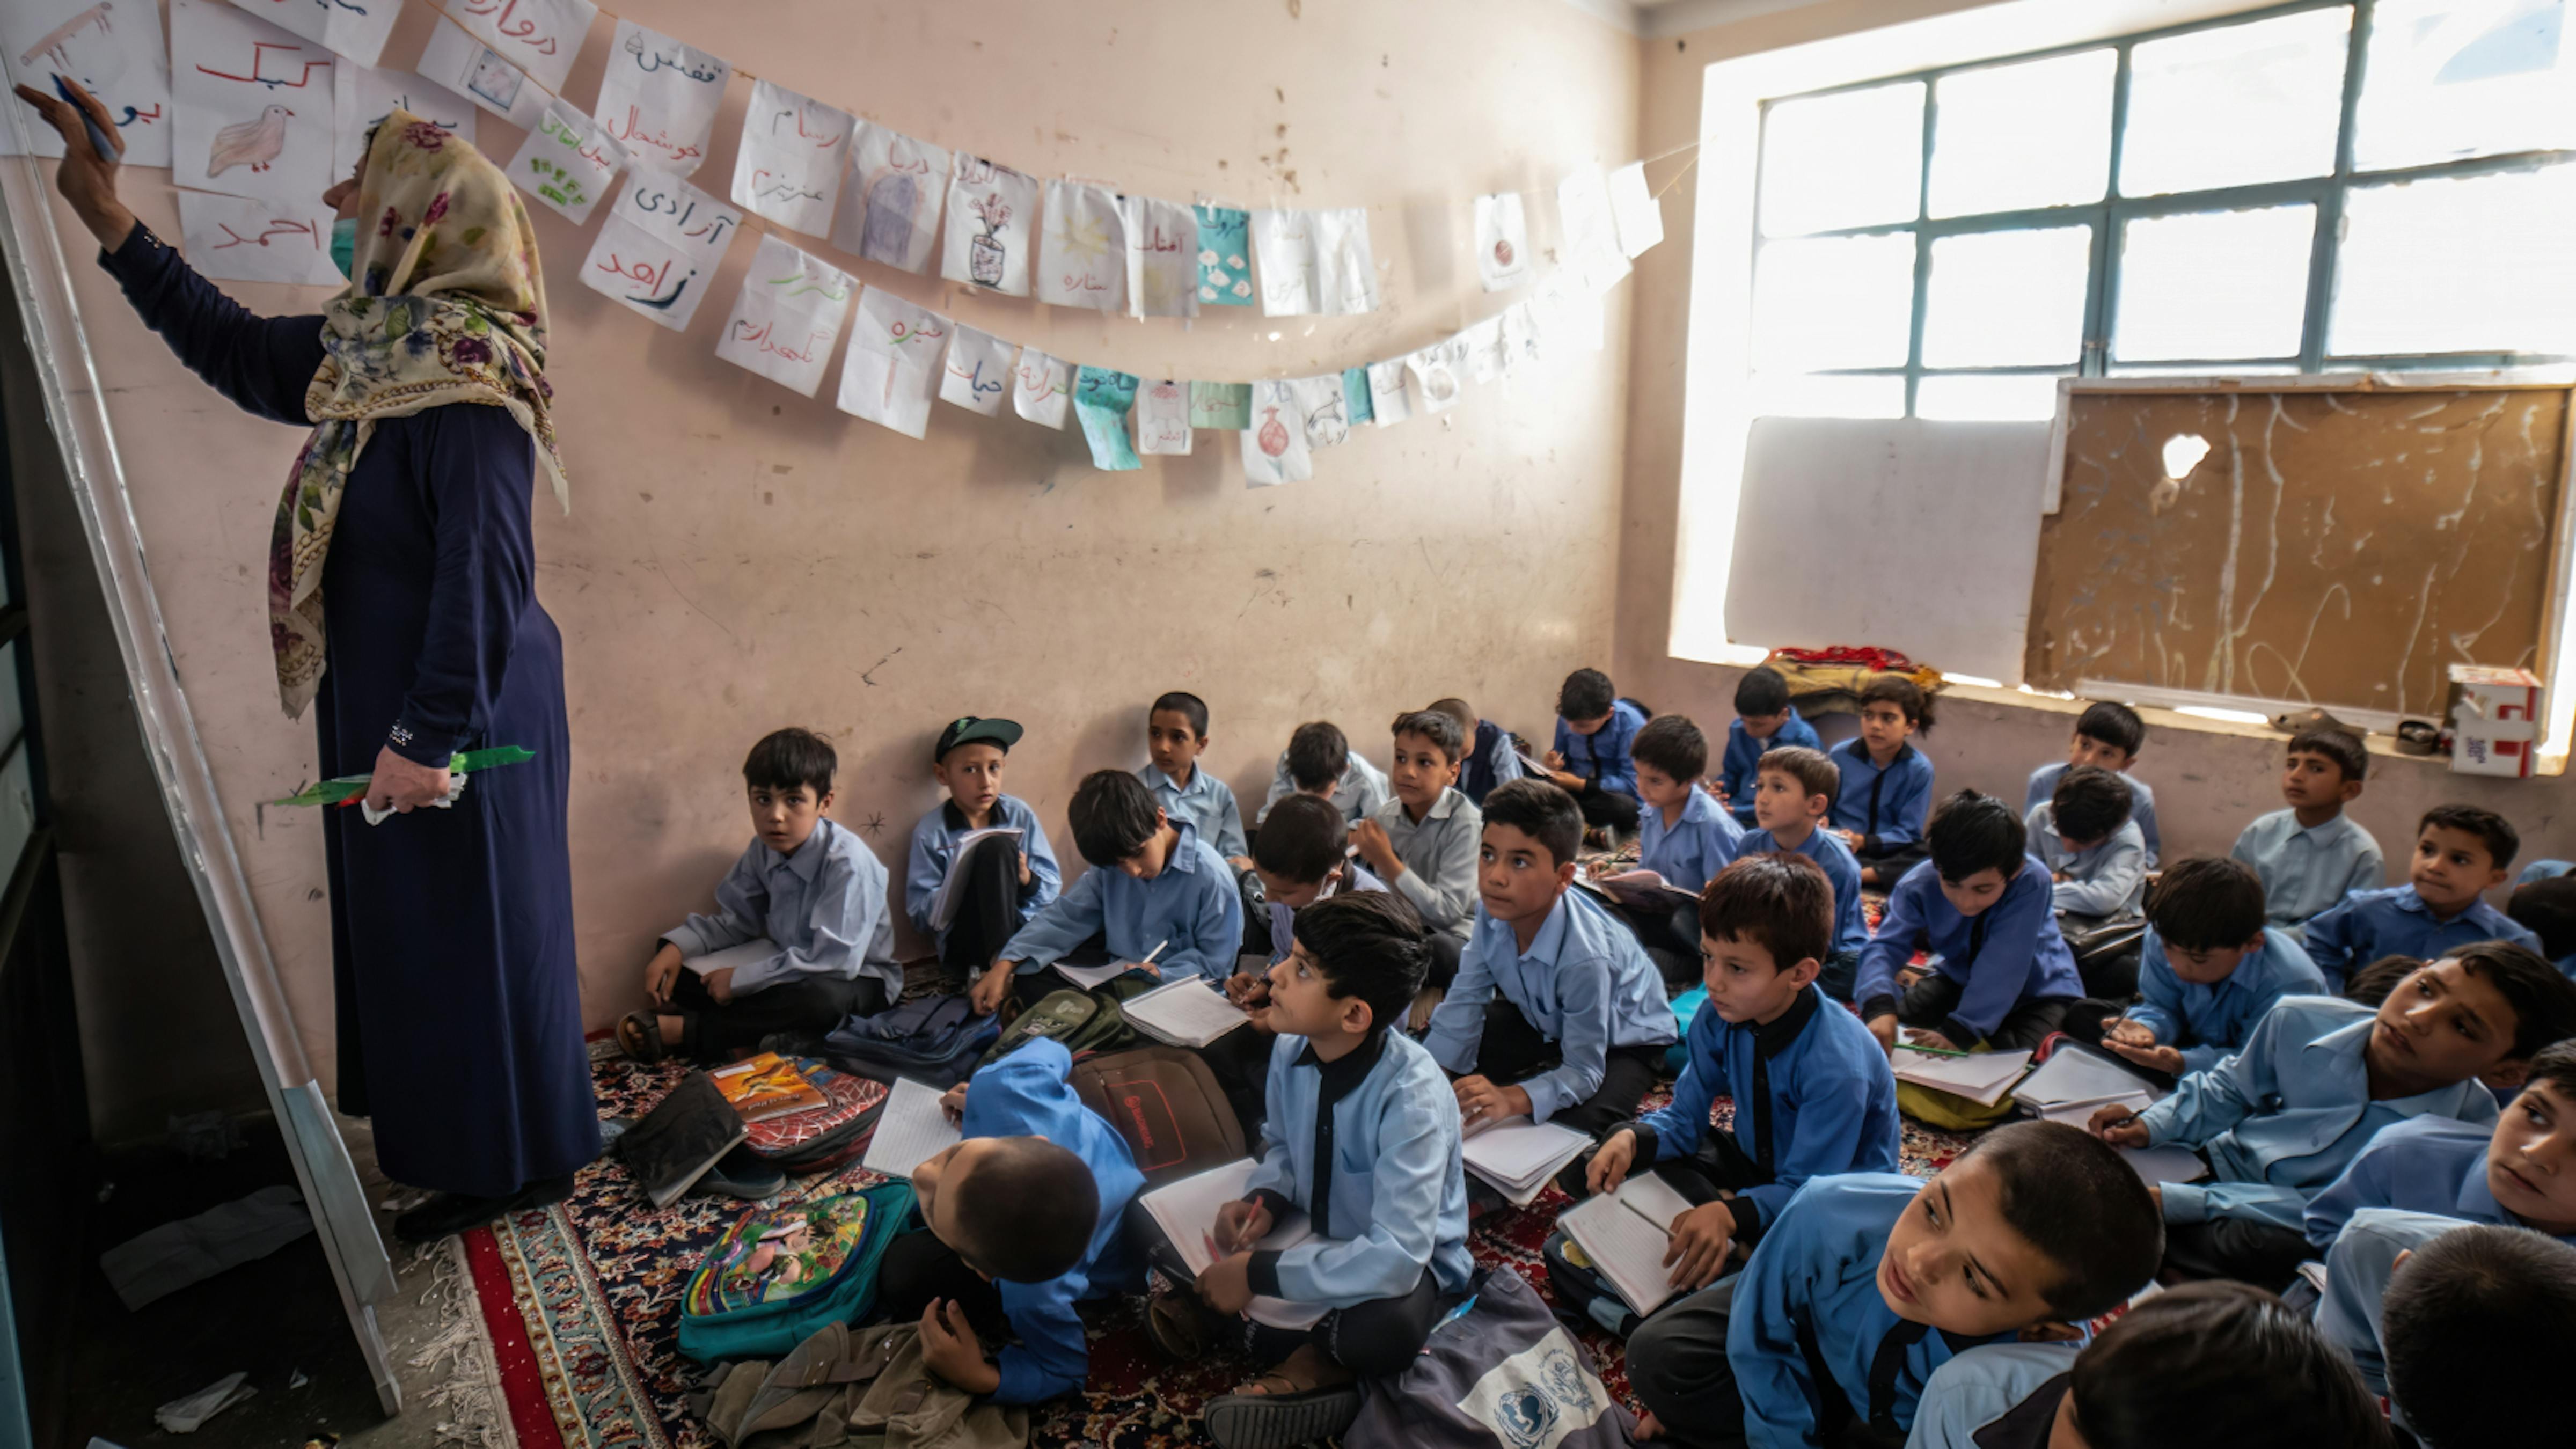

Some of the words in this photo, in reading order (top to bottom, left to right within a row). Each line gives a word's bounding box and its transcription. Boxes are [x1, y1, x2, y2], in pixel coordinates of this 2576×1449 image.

[213, 218, 319, 250] احمد
[635, 187, 734, 245] آزادی
[597, 253, 697, 310] زاهد
[948, 360, 1002, 402] حیات
